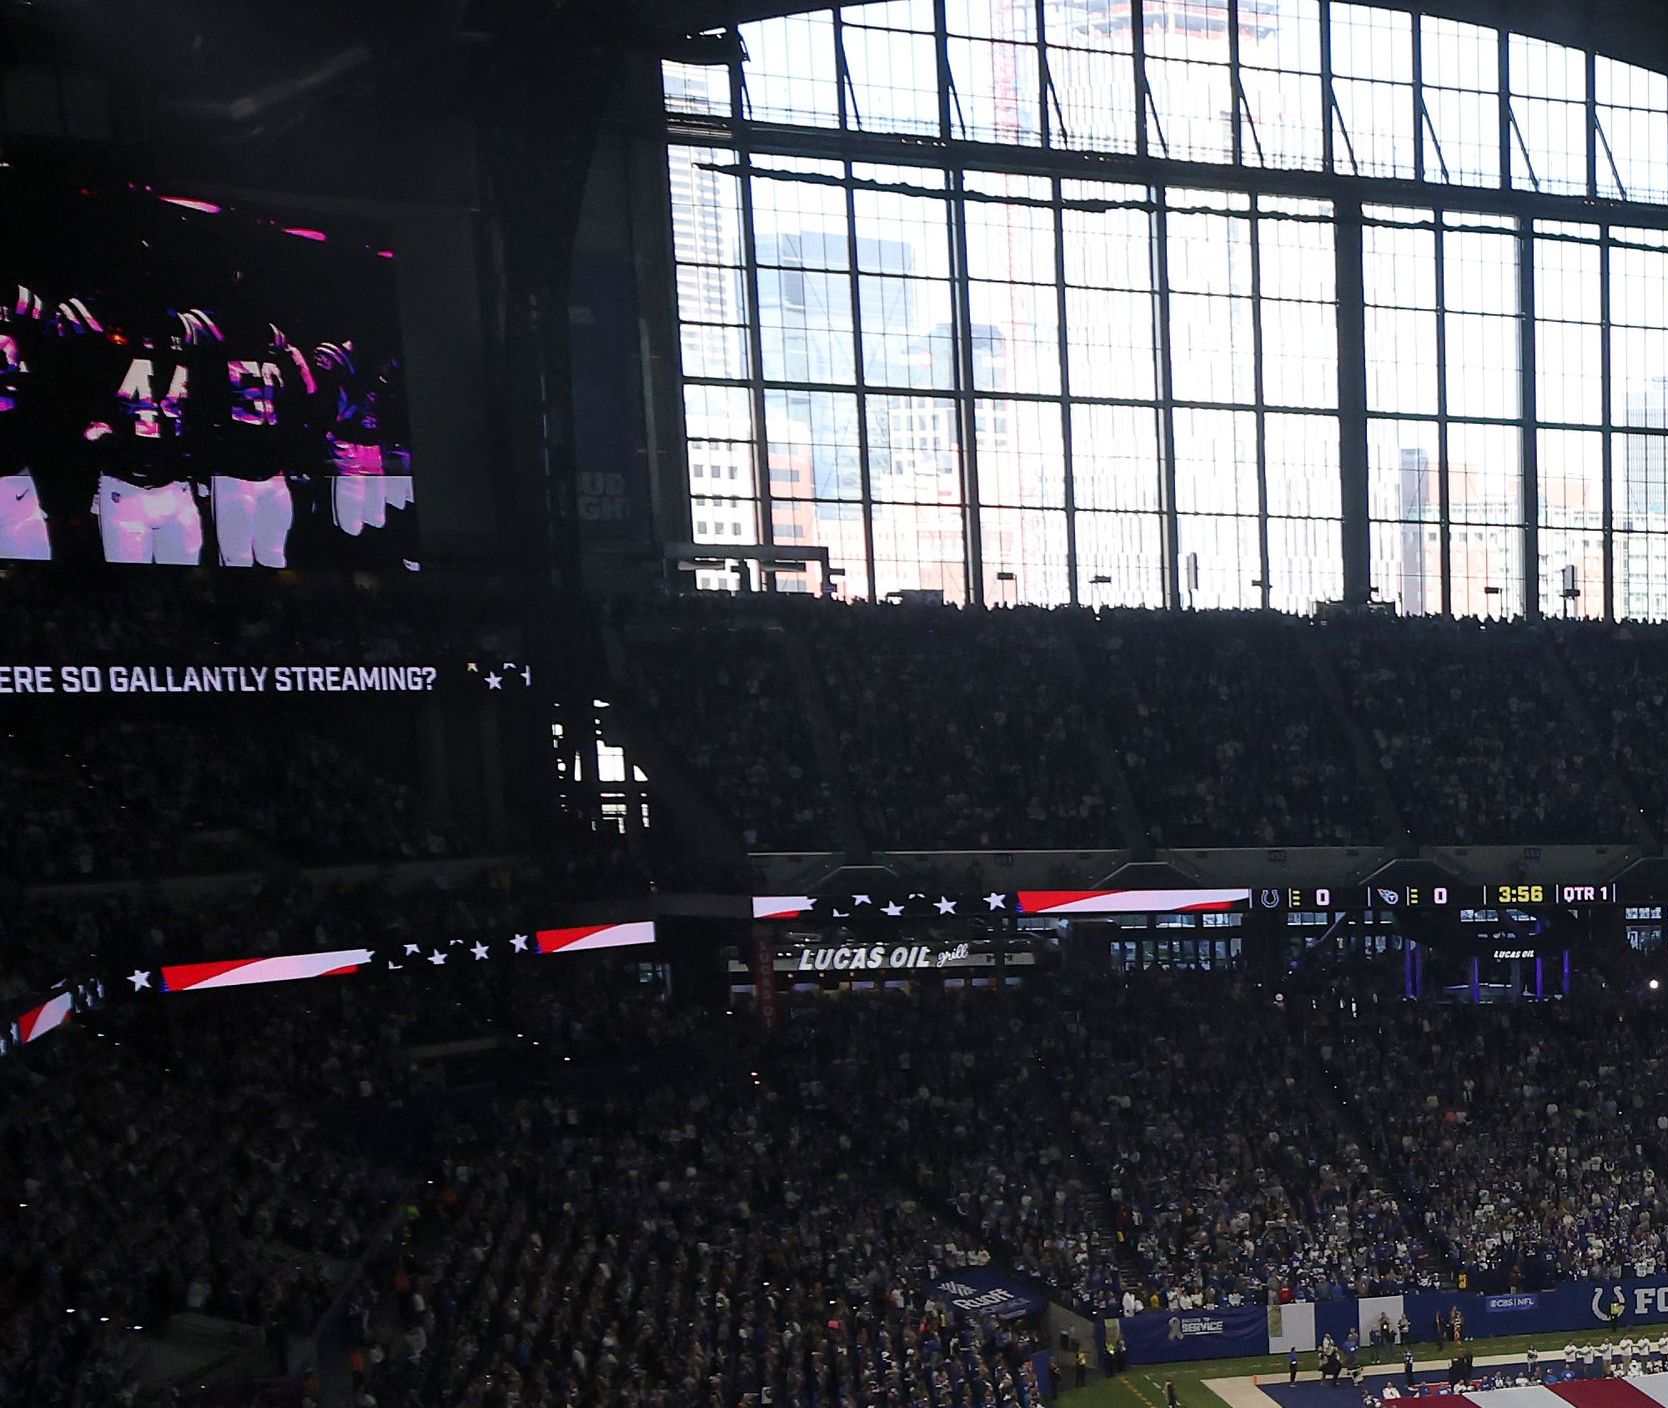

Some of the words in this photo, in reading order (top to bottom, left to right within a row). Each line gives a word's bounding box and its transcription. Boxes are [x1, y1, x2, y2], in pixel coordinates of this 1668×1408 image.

[62, 666, 101, 693] SO
[109, 666, 269, 693] GALLANTLY
[274, 665, 437, 692] STREAMING?
[1316, 888, 1330, 906] 0
[1433, 887, 1449, 905] 0
[1498, 885, 1544, 903] 3:56
[1563, 885, 1595, 903] QTR
[1599, 885, 1608, 902] 1
[799, 946, 887, 971] LUCAS
[889, 946, 932, 969] OIL
[936, 942, 969, 969] grill
[1493, 949, 1520, 960] LUCAS
